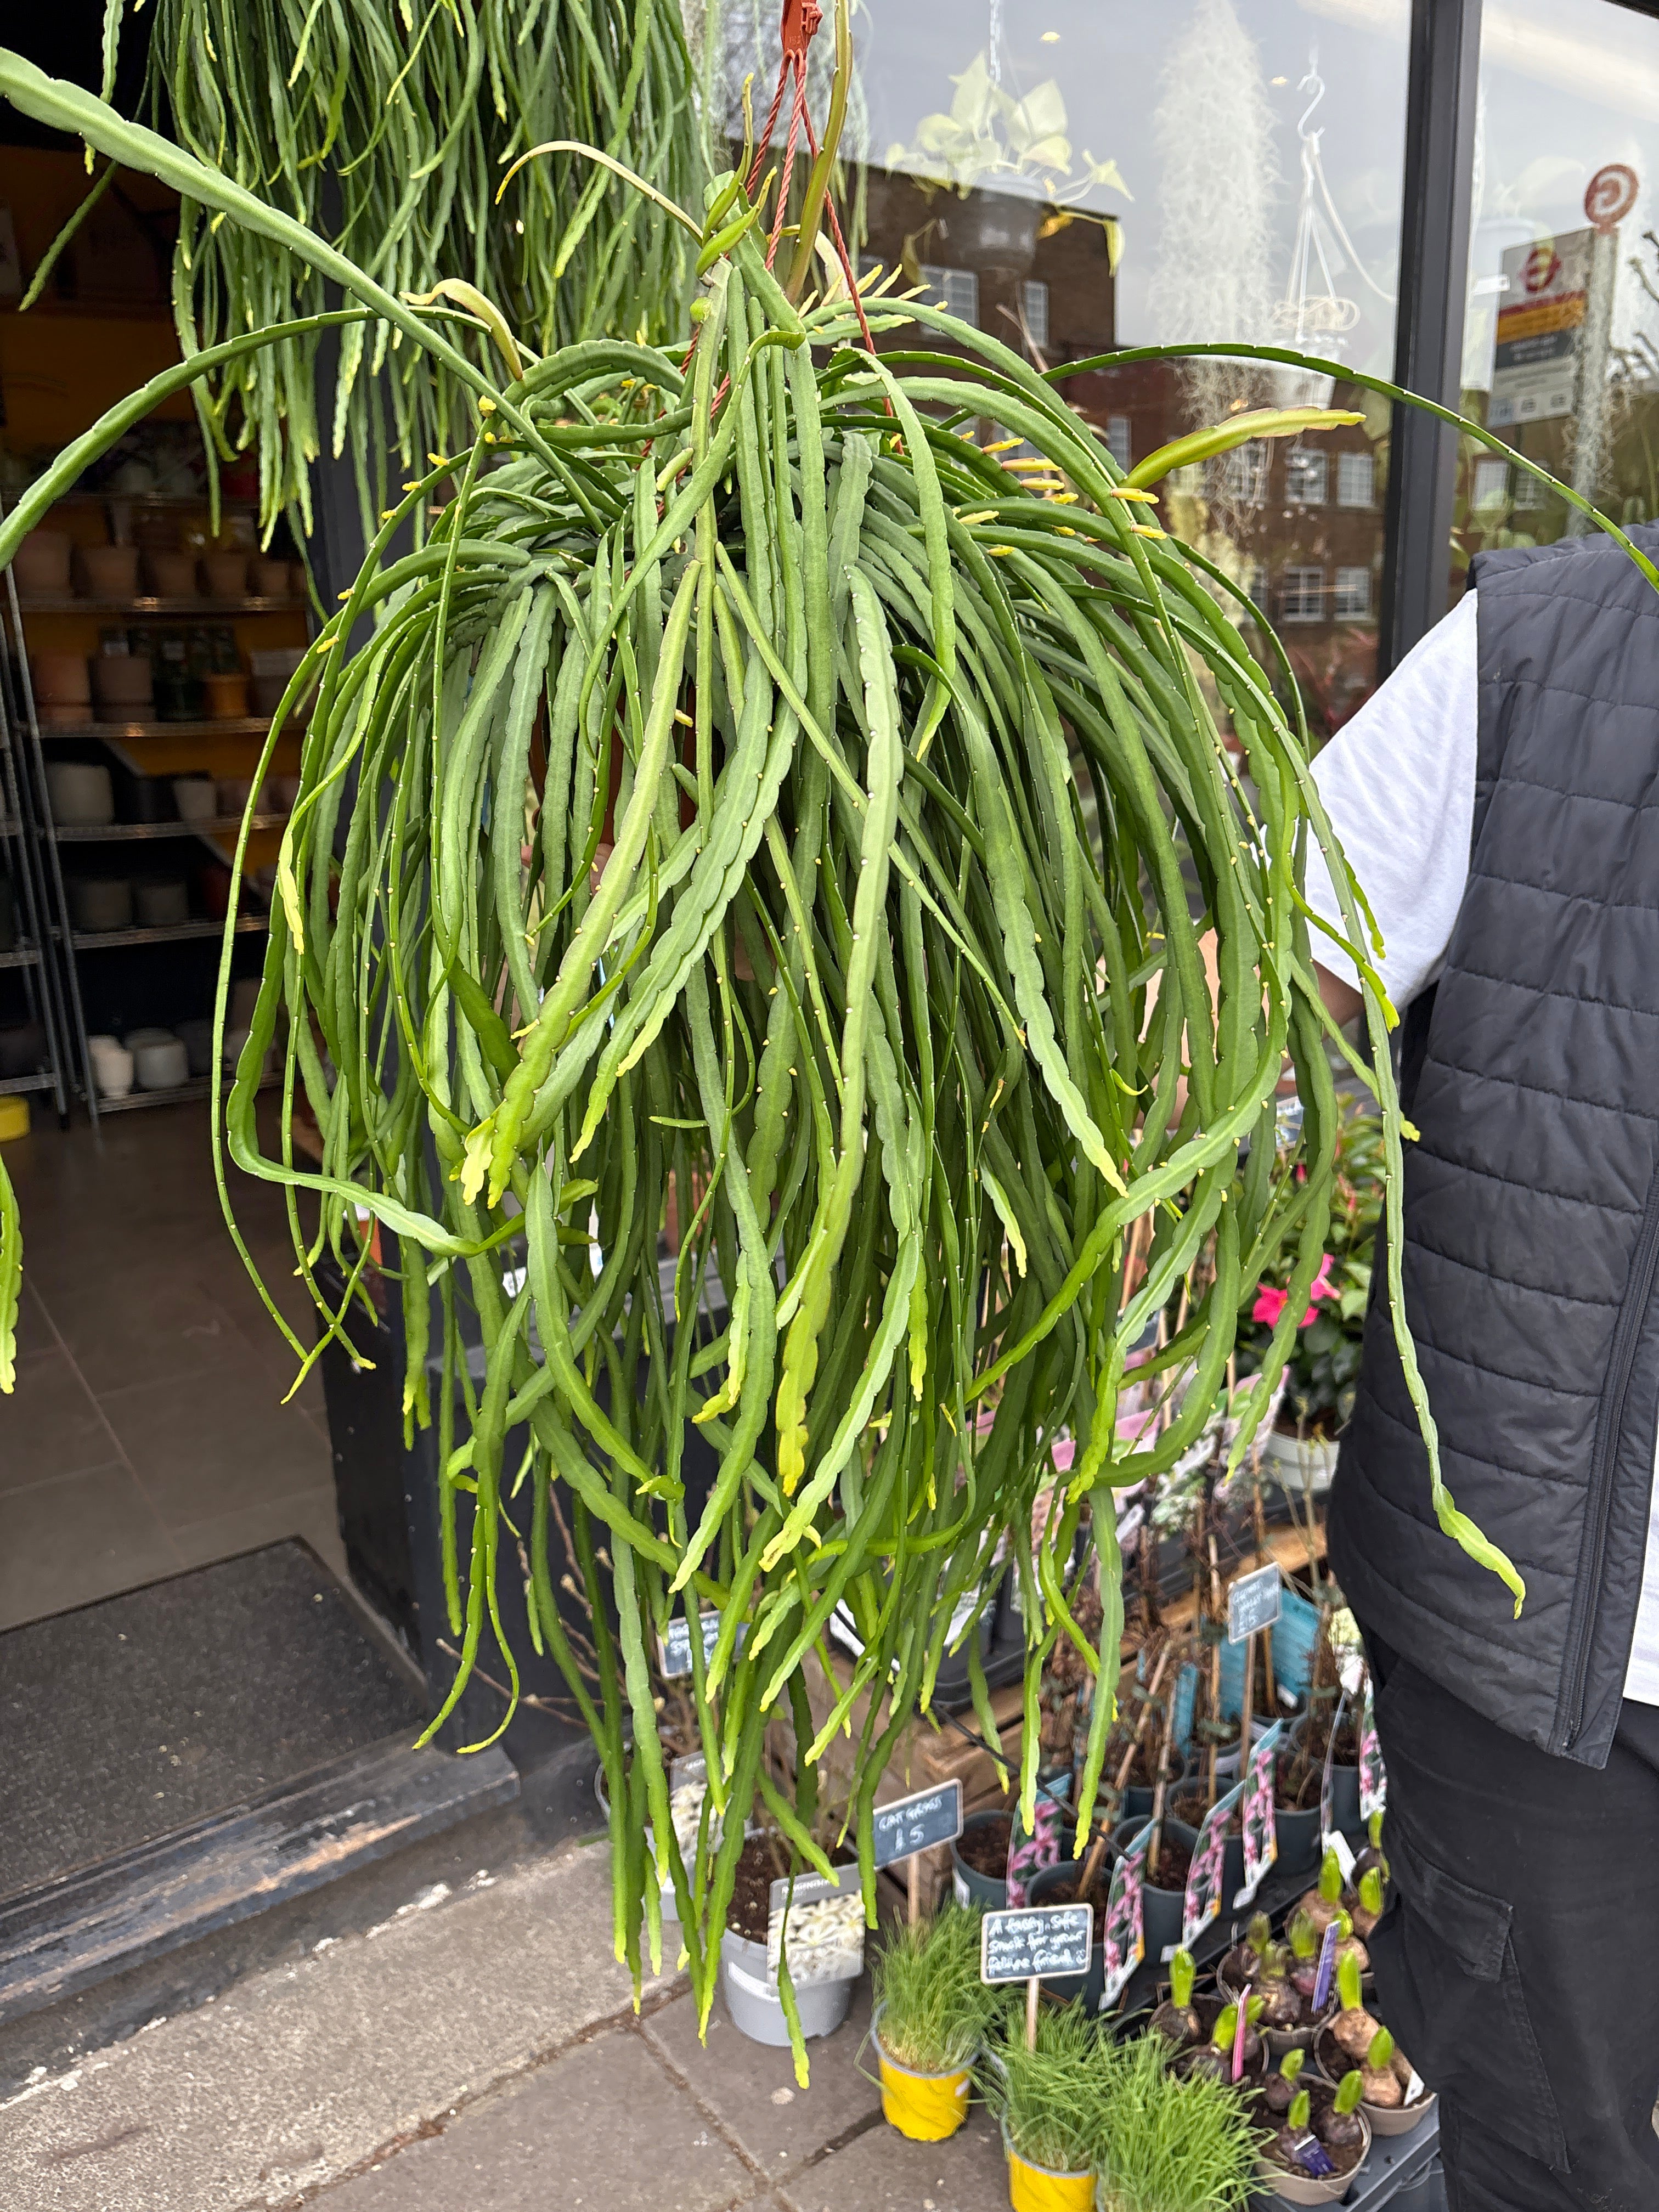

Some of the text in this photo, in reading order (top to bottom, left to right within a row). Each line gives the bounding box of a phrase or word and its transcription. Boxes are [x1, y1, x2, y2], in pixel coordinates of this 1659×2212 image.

[879, 1812, 905, 1832] CAT
[1026, 1932, 1049, 1951] for
[1049, 1930, 1086, 1951] your
